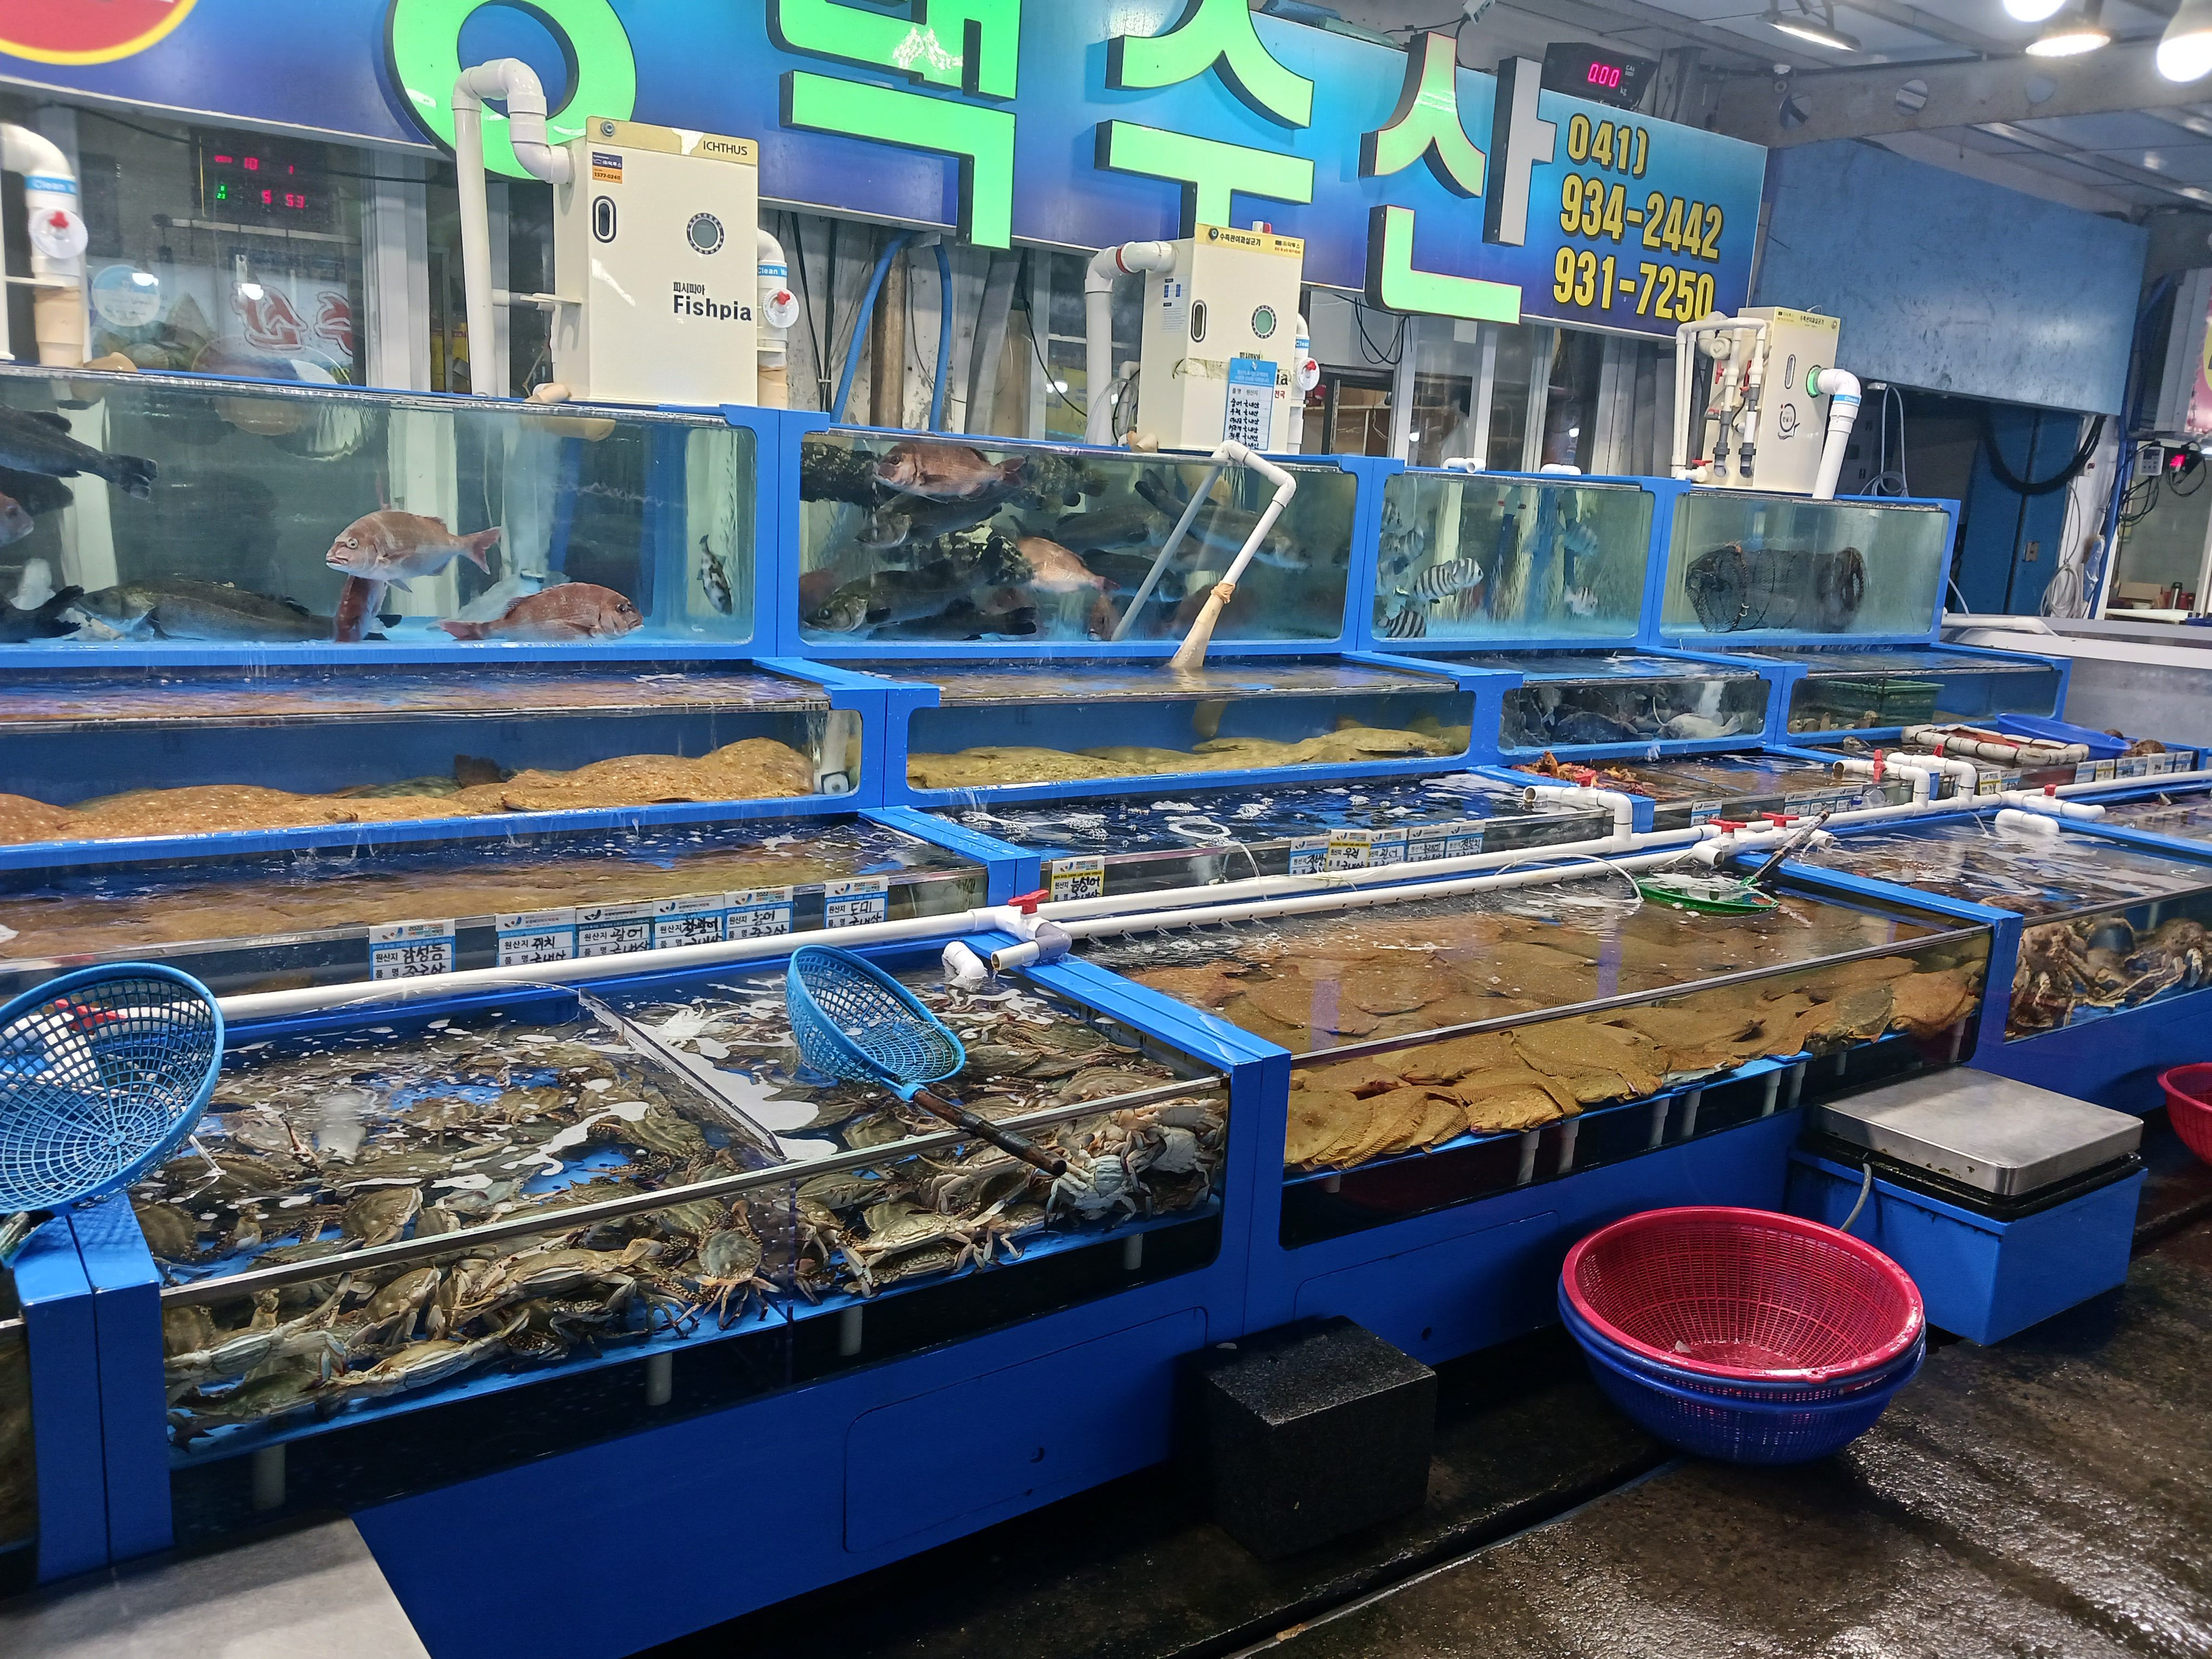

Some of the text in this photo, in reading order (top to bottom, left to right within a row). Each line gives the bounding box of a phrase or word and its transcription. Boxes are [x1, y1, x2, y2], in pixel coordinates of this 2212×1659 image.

[703, 140, 748, 156] ICHTHUS
[1567, 114, 1648, 177] 041)
[1560, 173, 1723, 260] 934-2442
[757, 267, 778, 275] Clean
[1553, 247, 1714, 322] 931-7250
[674, 294, 751, 321] Fishpia
[829, 901, 872, 916] 원산지 도미
[729, 915, 747, 925] 원산지
[584, 931, 607, 942] 원산지
[610, 926, 643, 942] 광어
[504, 936, 555, 950] 원산지 쥐치
[375, 952, 398, 963] 원산지
[402, 943, 446, 964] 감성돔
